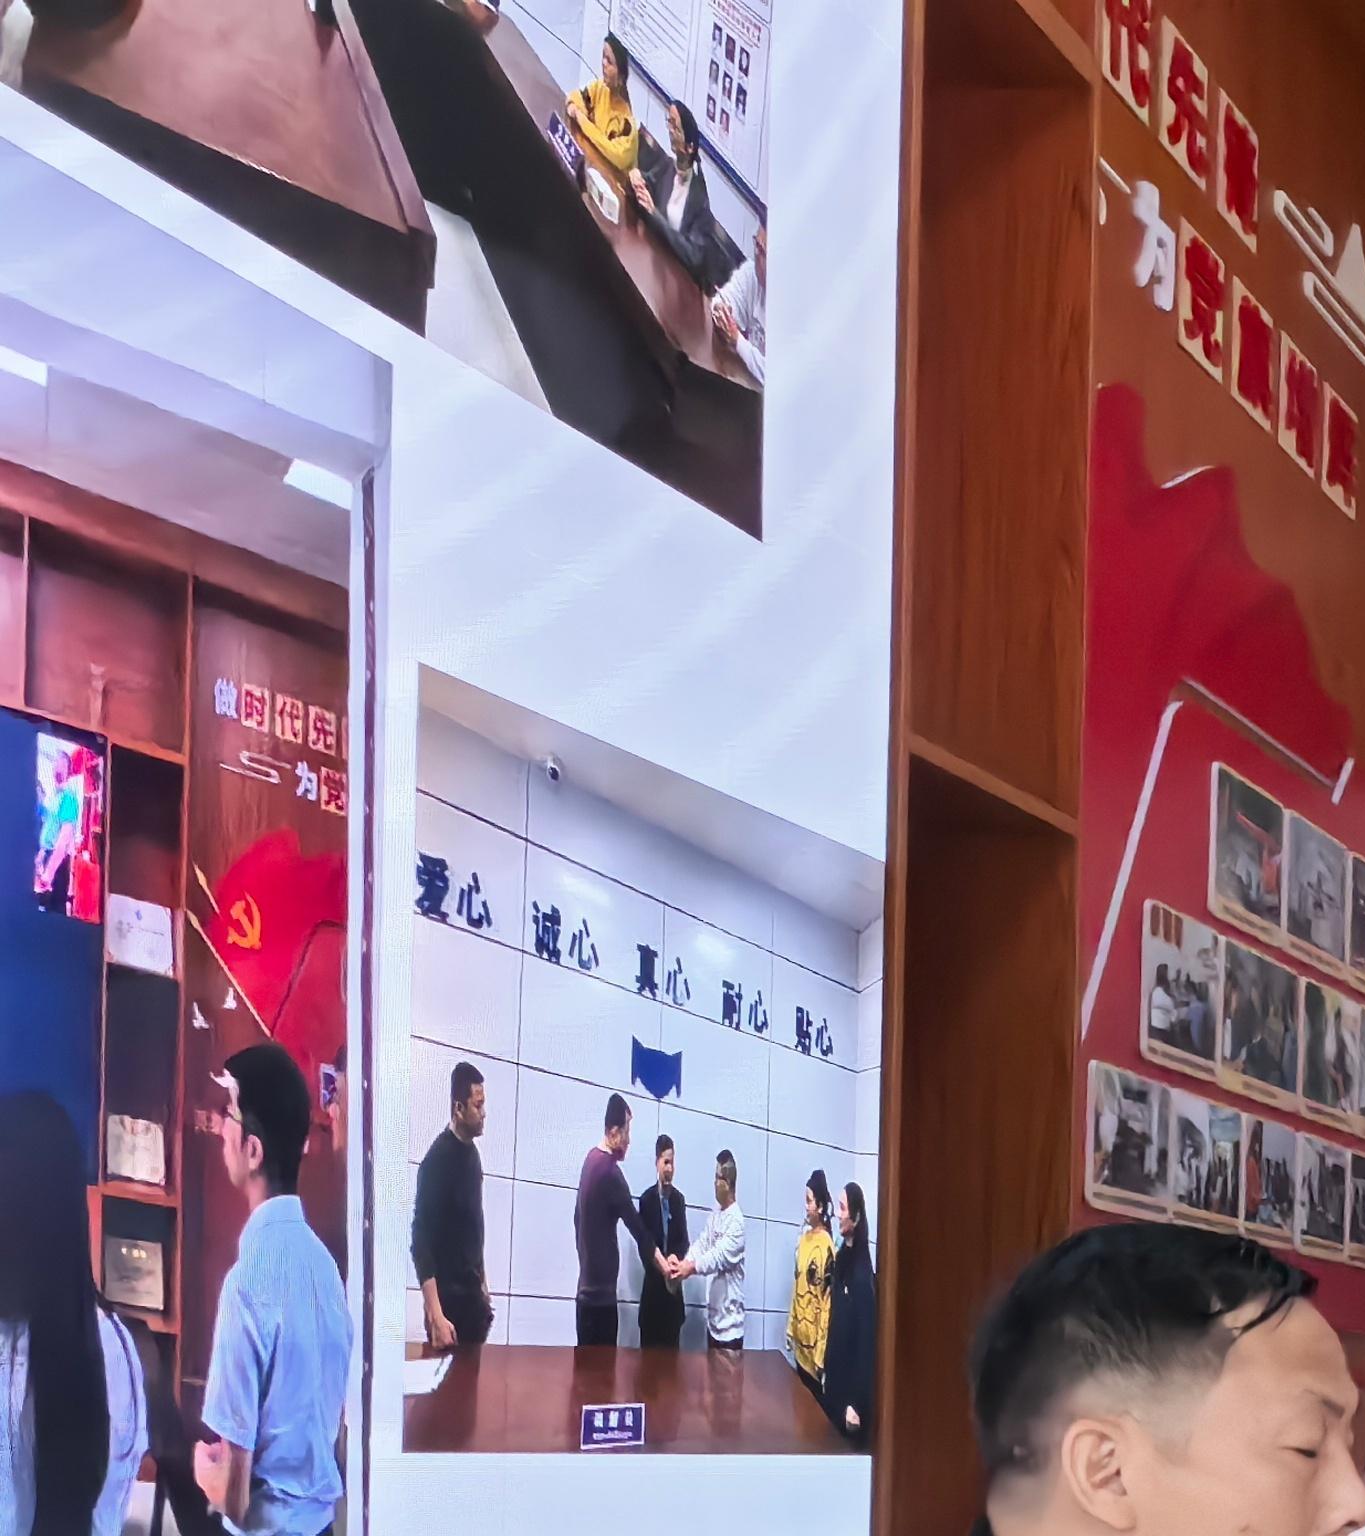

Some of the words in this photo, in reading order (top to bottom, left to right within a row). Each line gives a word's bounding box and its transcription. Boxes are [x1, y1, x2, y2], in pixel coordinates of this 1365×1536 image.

[214, 678, 347, 761] 做时代先
[415, 850, 492, 928] 爱心
[533, 901, 600, 971] 诚心
